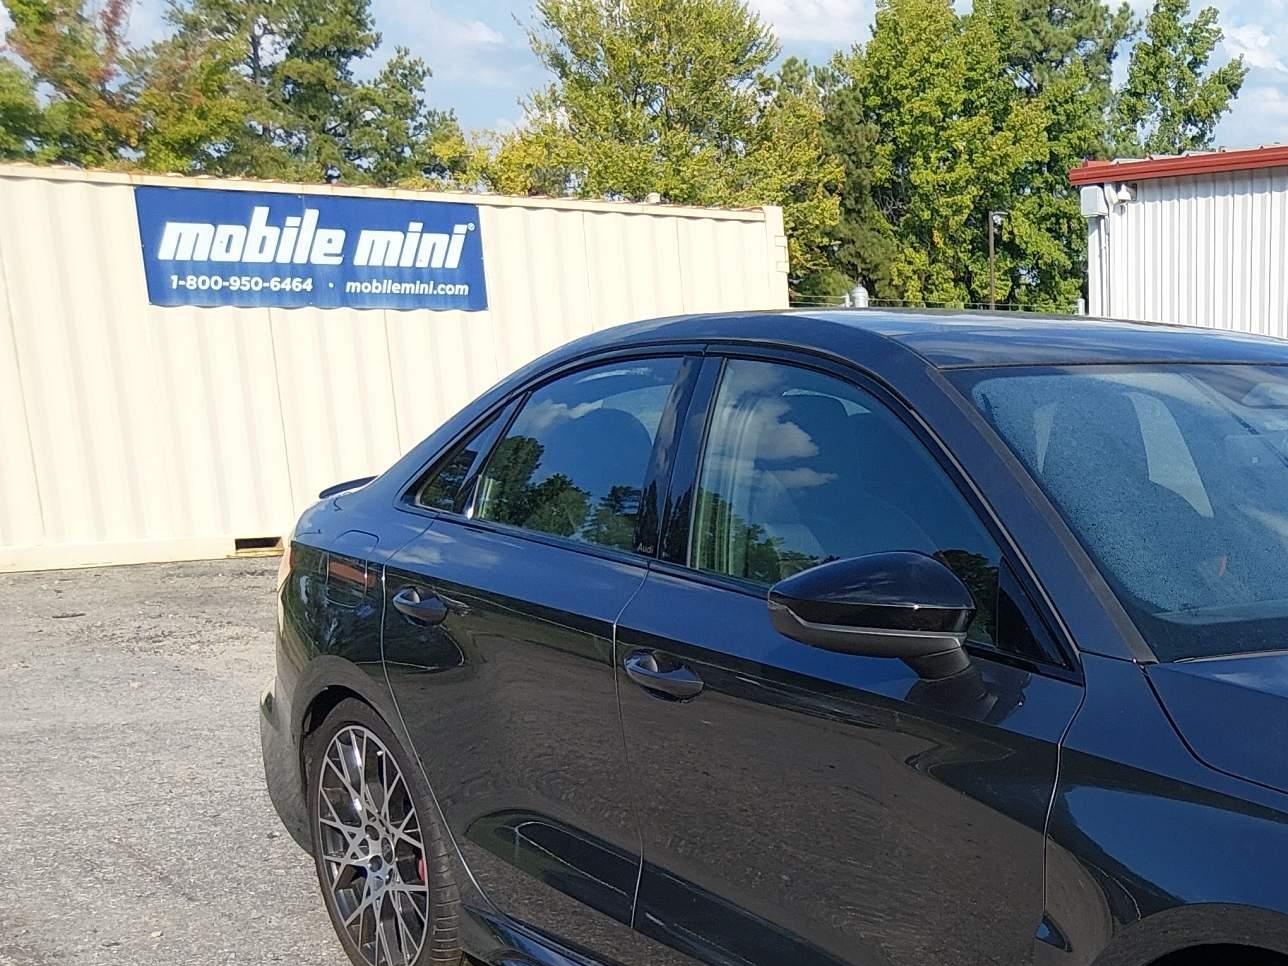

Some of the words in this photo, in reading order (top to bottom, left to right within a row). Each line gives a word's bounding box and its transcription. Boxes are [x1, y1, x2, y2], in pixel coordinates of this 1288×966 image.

[157, 206, 346, 265] mobile
[170, 274, 313, 292] 1-800-950-6464
[345, 278, 469, 296] mobilemini.com
